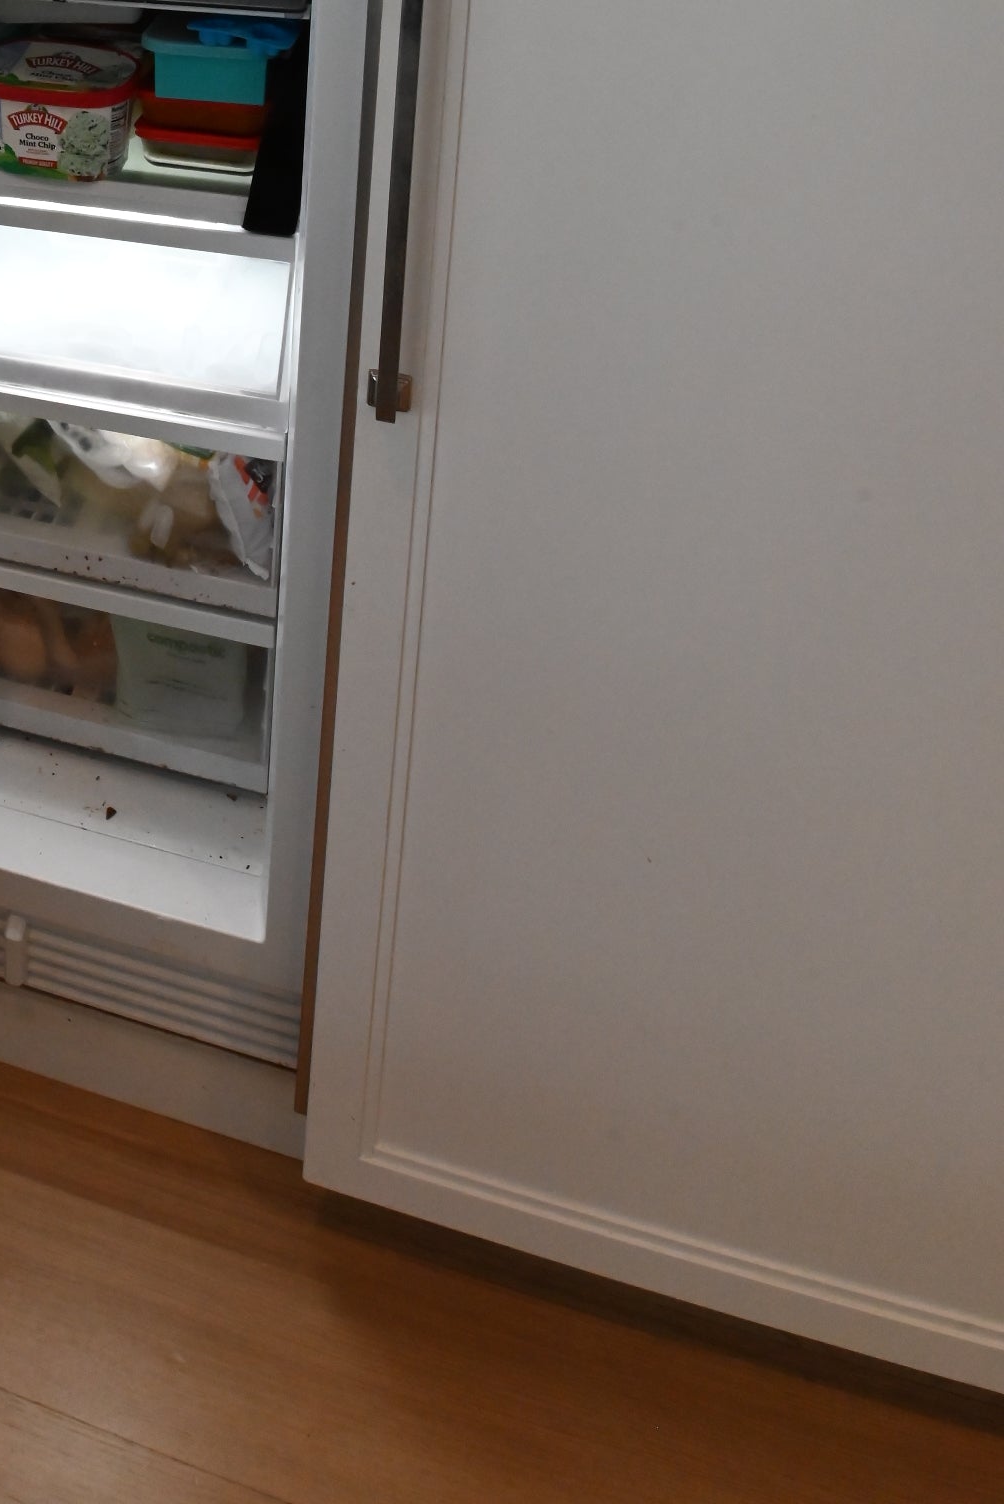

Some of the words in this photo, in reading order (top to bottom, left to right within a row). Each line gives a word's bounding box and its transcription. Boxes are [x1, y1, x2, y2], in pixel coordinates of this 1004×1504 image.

[30, 57, 74, 68] TURKEY
[73, 59, 97, 74] HILL
[9, 113, 45, 129] TURKEY
[44, 114, 64, 132] HILL
[25, 132, 49, 142] Choco
[19, 139, 37, 147] Mint
[37, 141, 56, 151] Chip
